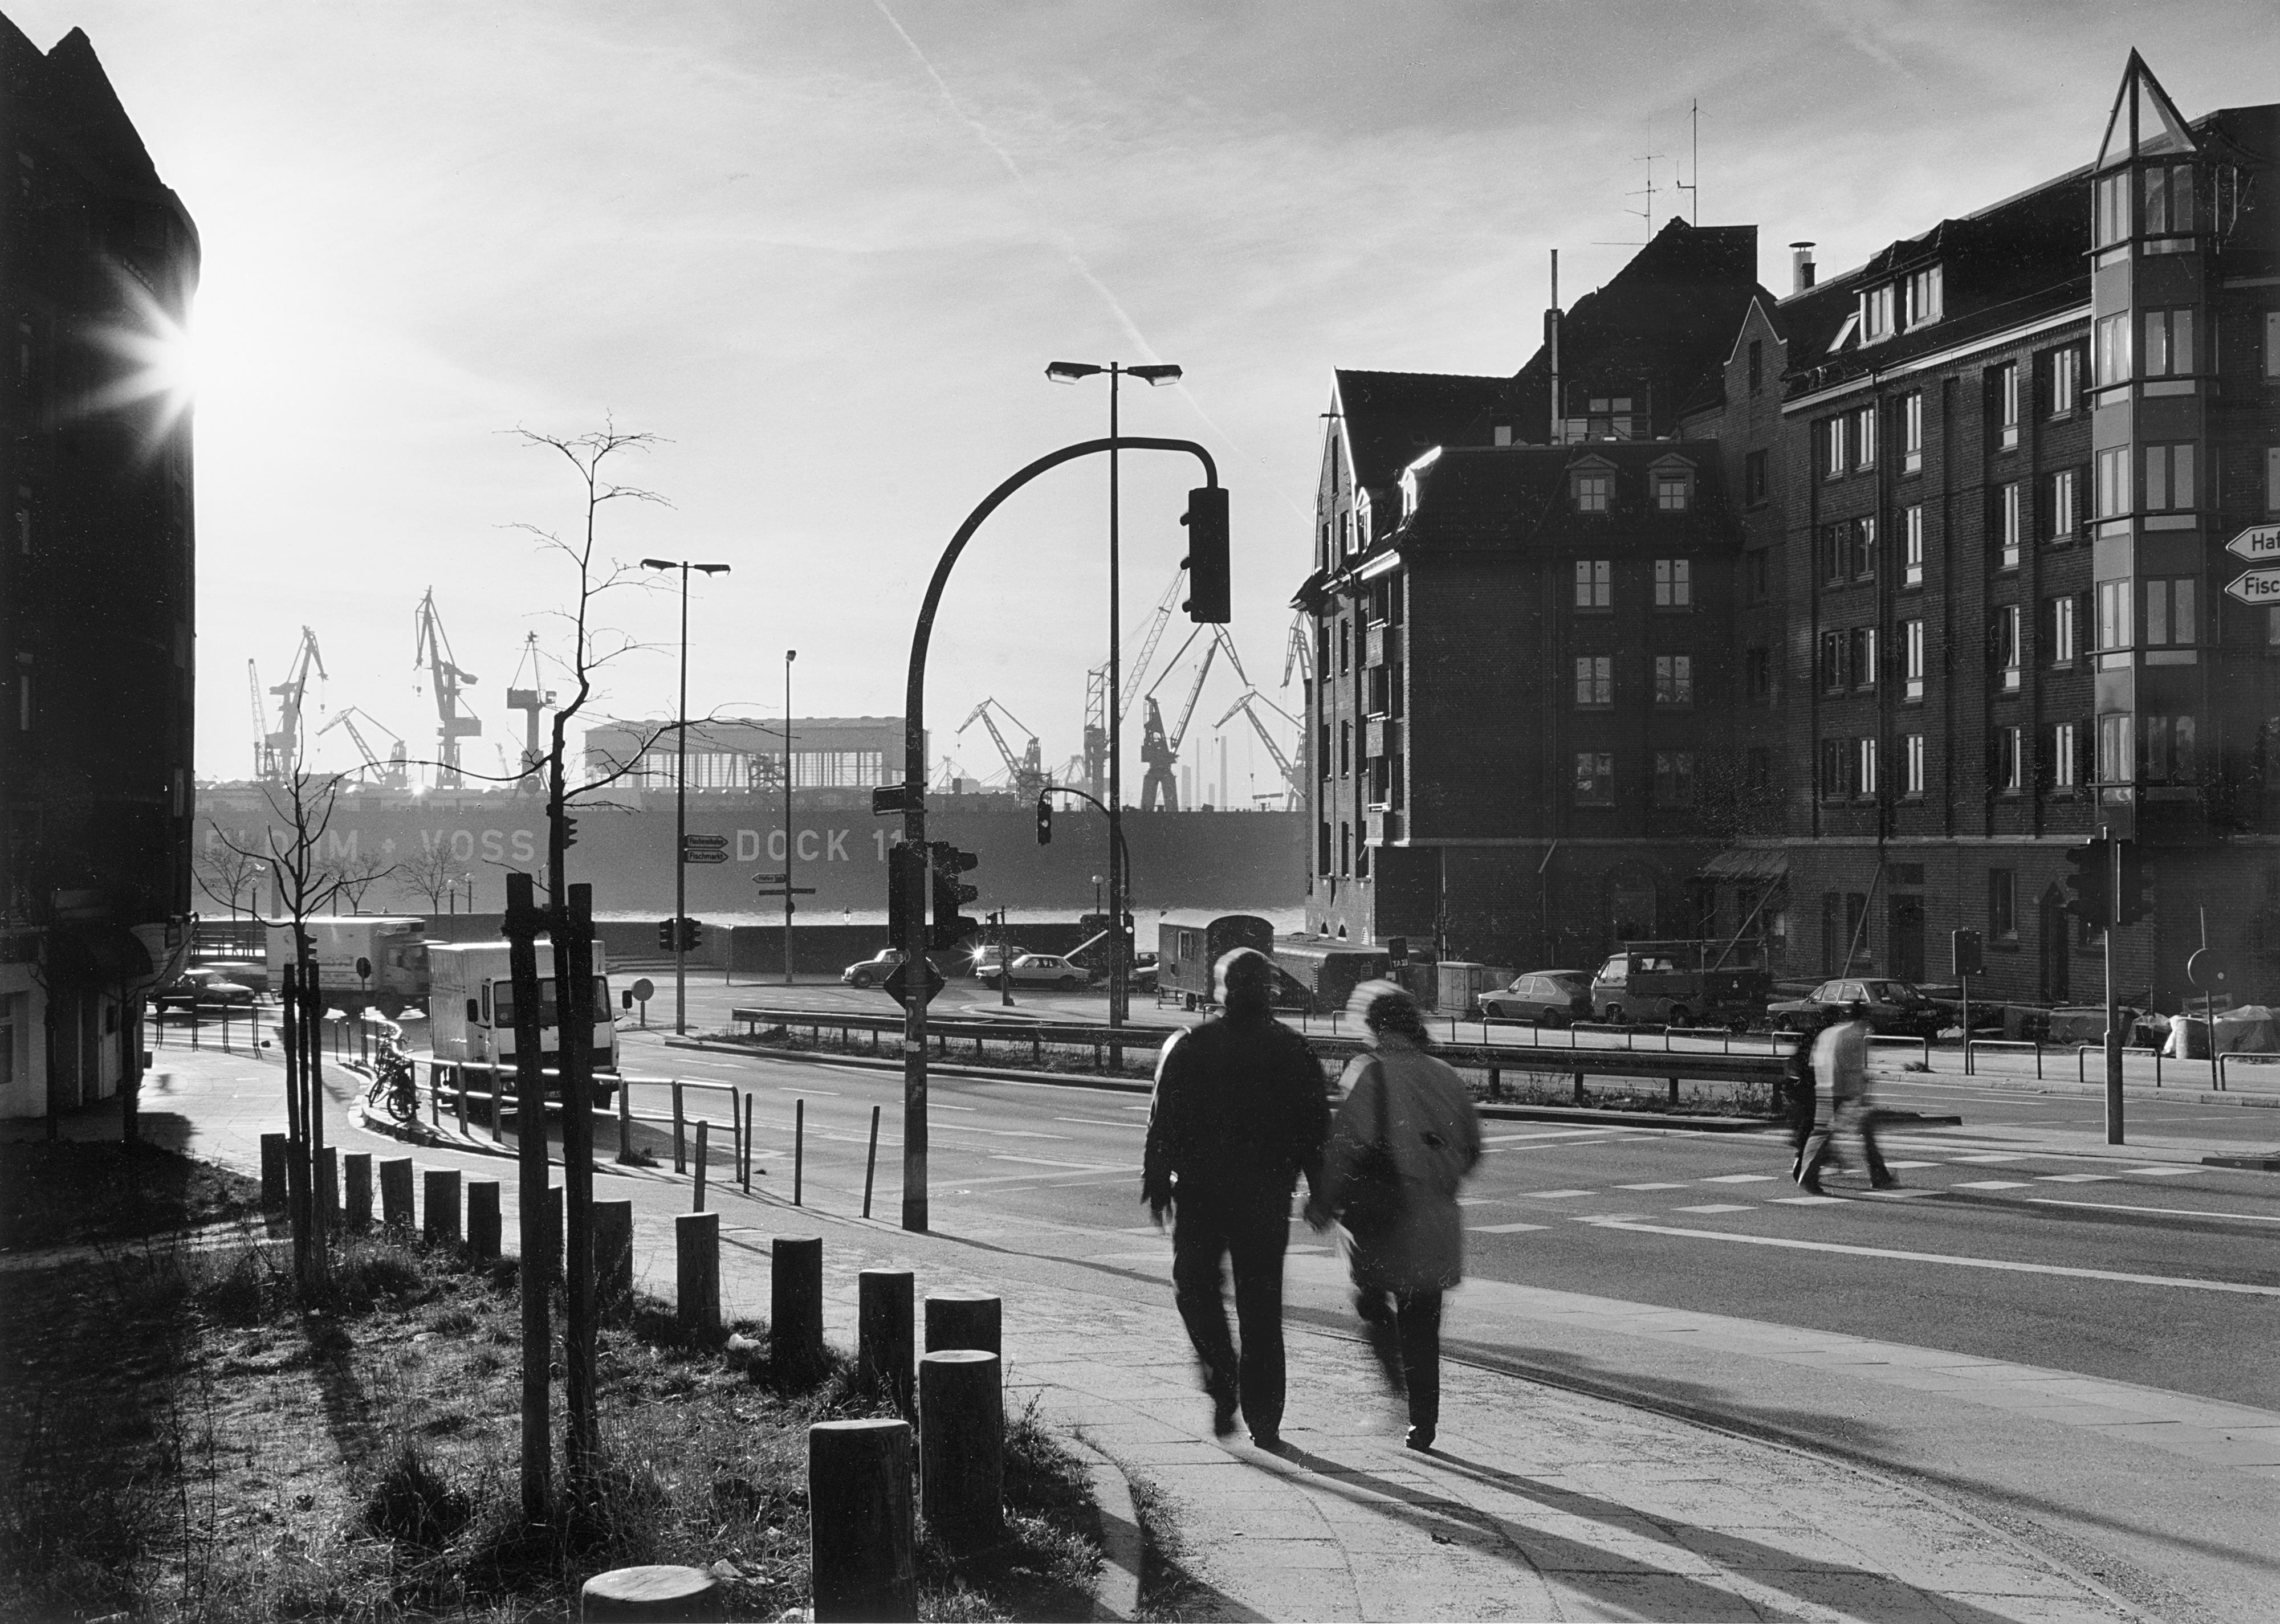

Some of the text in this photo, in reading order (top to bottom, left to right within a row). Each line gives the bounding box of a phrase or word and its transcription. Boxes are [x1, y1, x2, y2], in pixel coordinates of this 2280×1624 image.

[2252, 531, 2280, 552] Haf
[2245, 577, 2279, 595] Fisc
[421, 829, 535, 862] VOSS
[736, 829, 850, 861] DOCK
